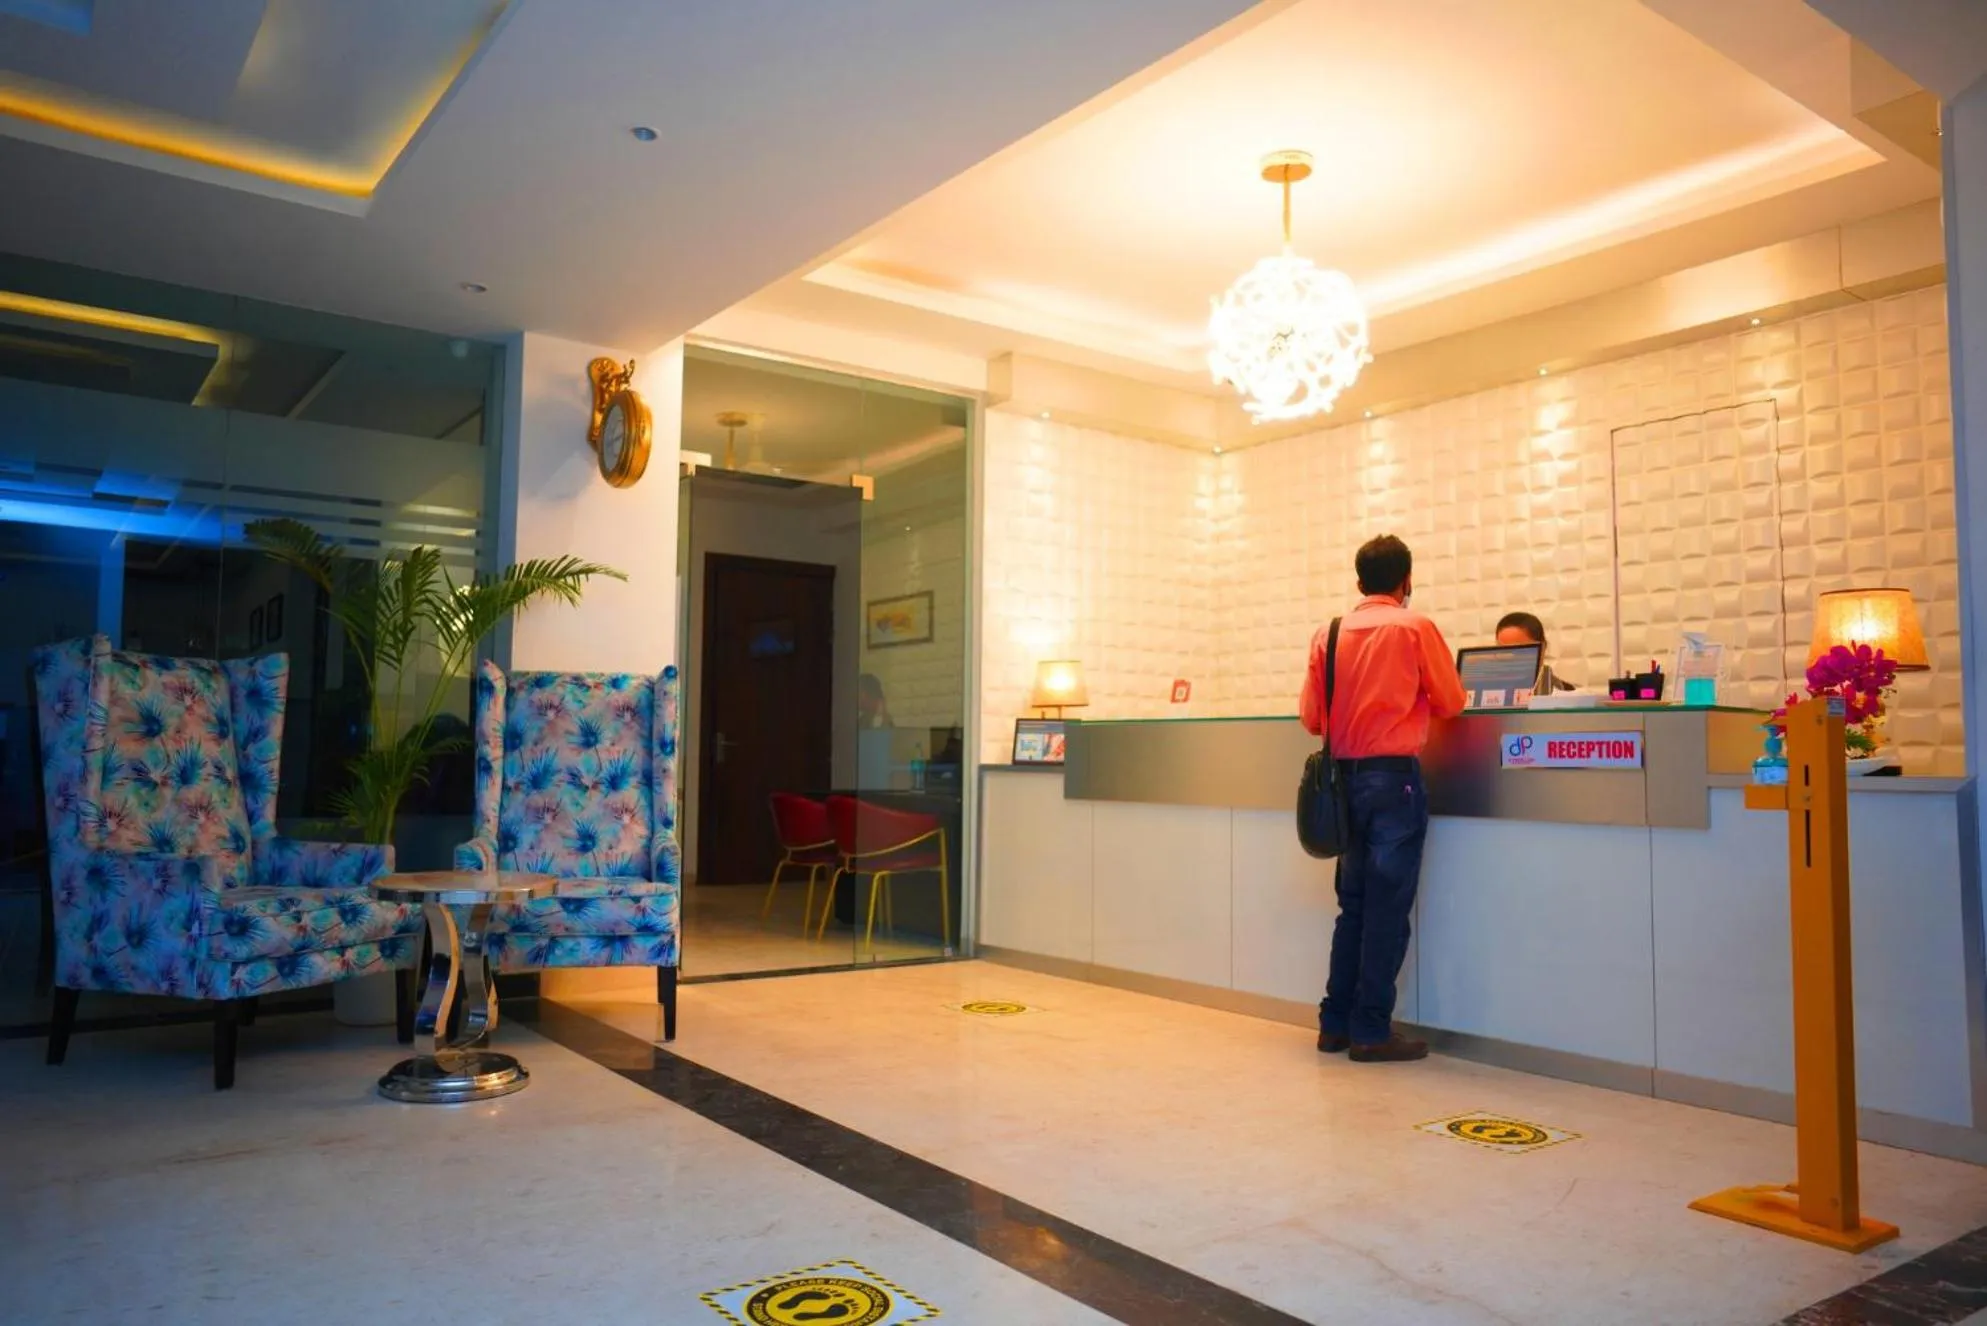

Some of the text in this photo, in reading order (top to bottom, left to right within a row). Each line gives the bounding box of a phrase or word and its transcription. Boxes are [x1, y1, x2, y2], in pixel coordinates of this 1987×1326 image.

[1546, 740, 1635, 759] RECEPTION
[774, 1278, 824, 1291] PLEASE
[827, 1278, 862, 1289] KEEP
